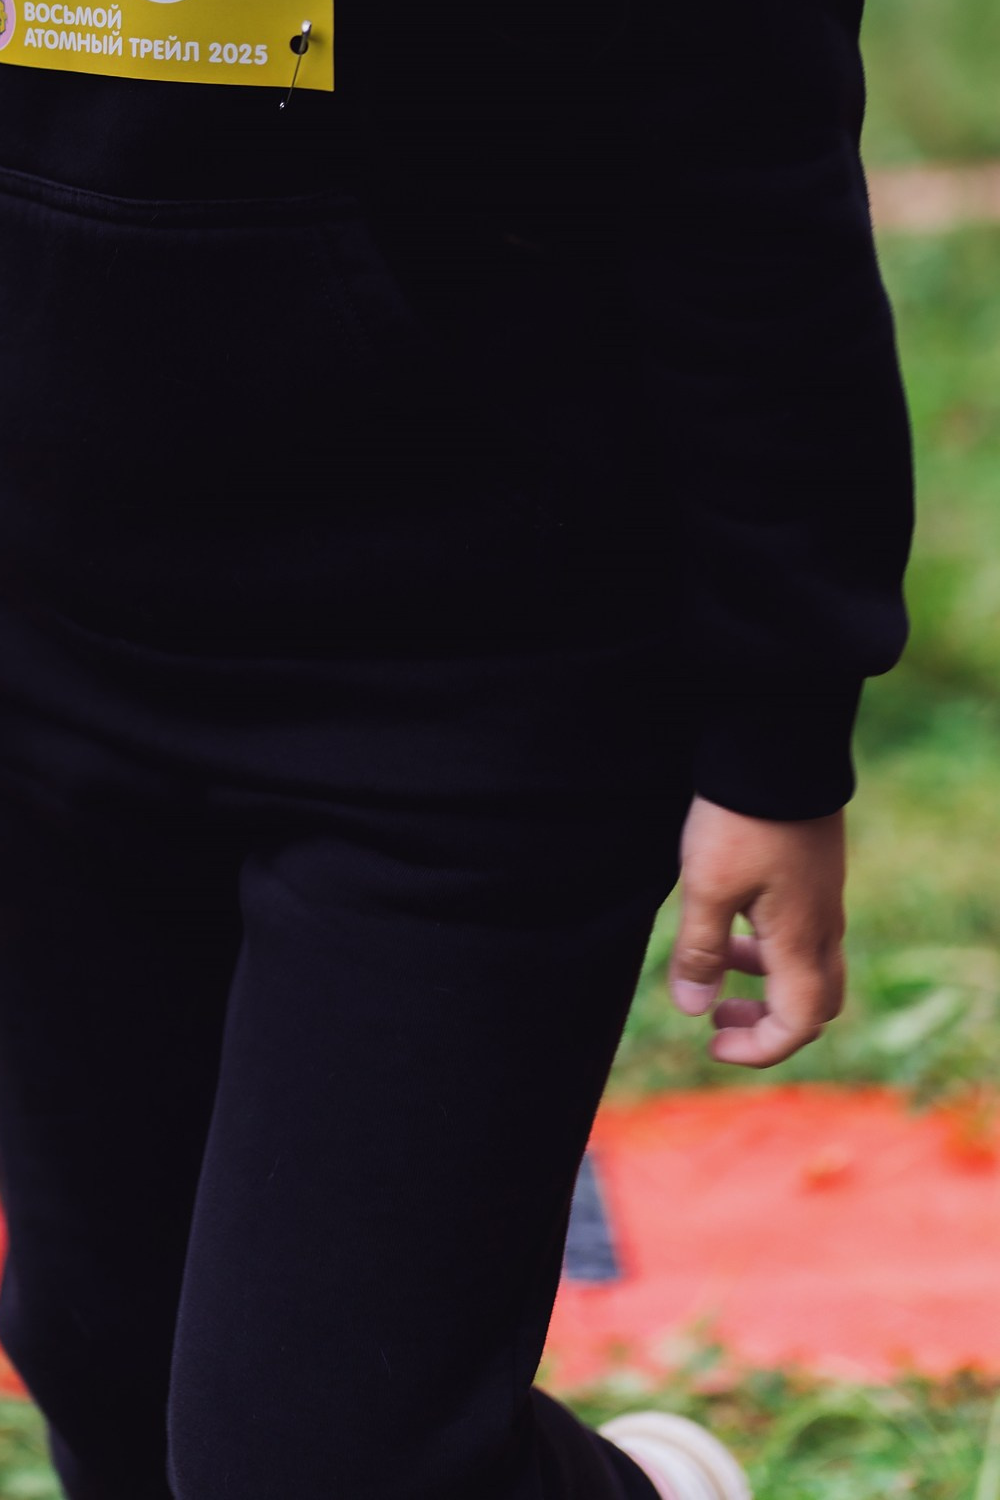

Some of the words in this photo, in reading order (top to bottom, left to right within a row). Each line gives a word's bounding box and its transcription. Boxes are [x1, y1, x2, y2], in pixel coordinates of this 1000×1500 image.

[24, 2, 122, 30] ВОСЬМОЙ
[24, 30, 123, 57] АТОМНЫЙ
[129, 35, 200, 62] ТРЕЙЛ
[208, 42, 268, 66] 2025
